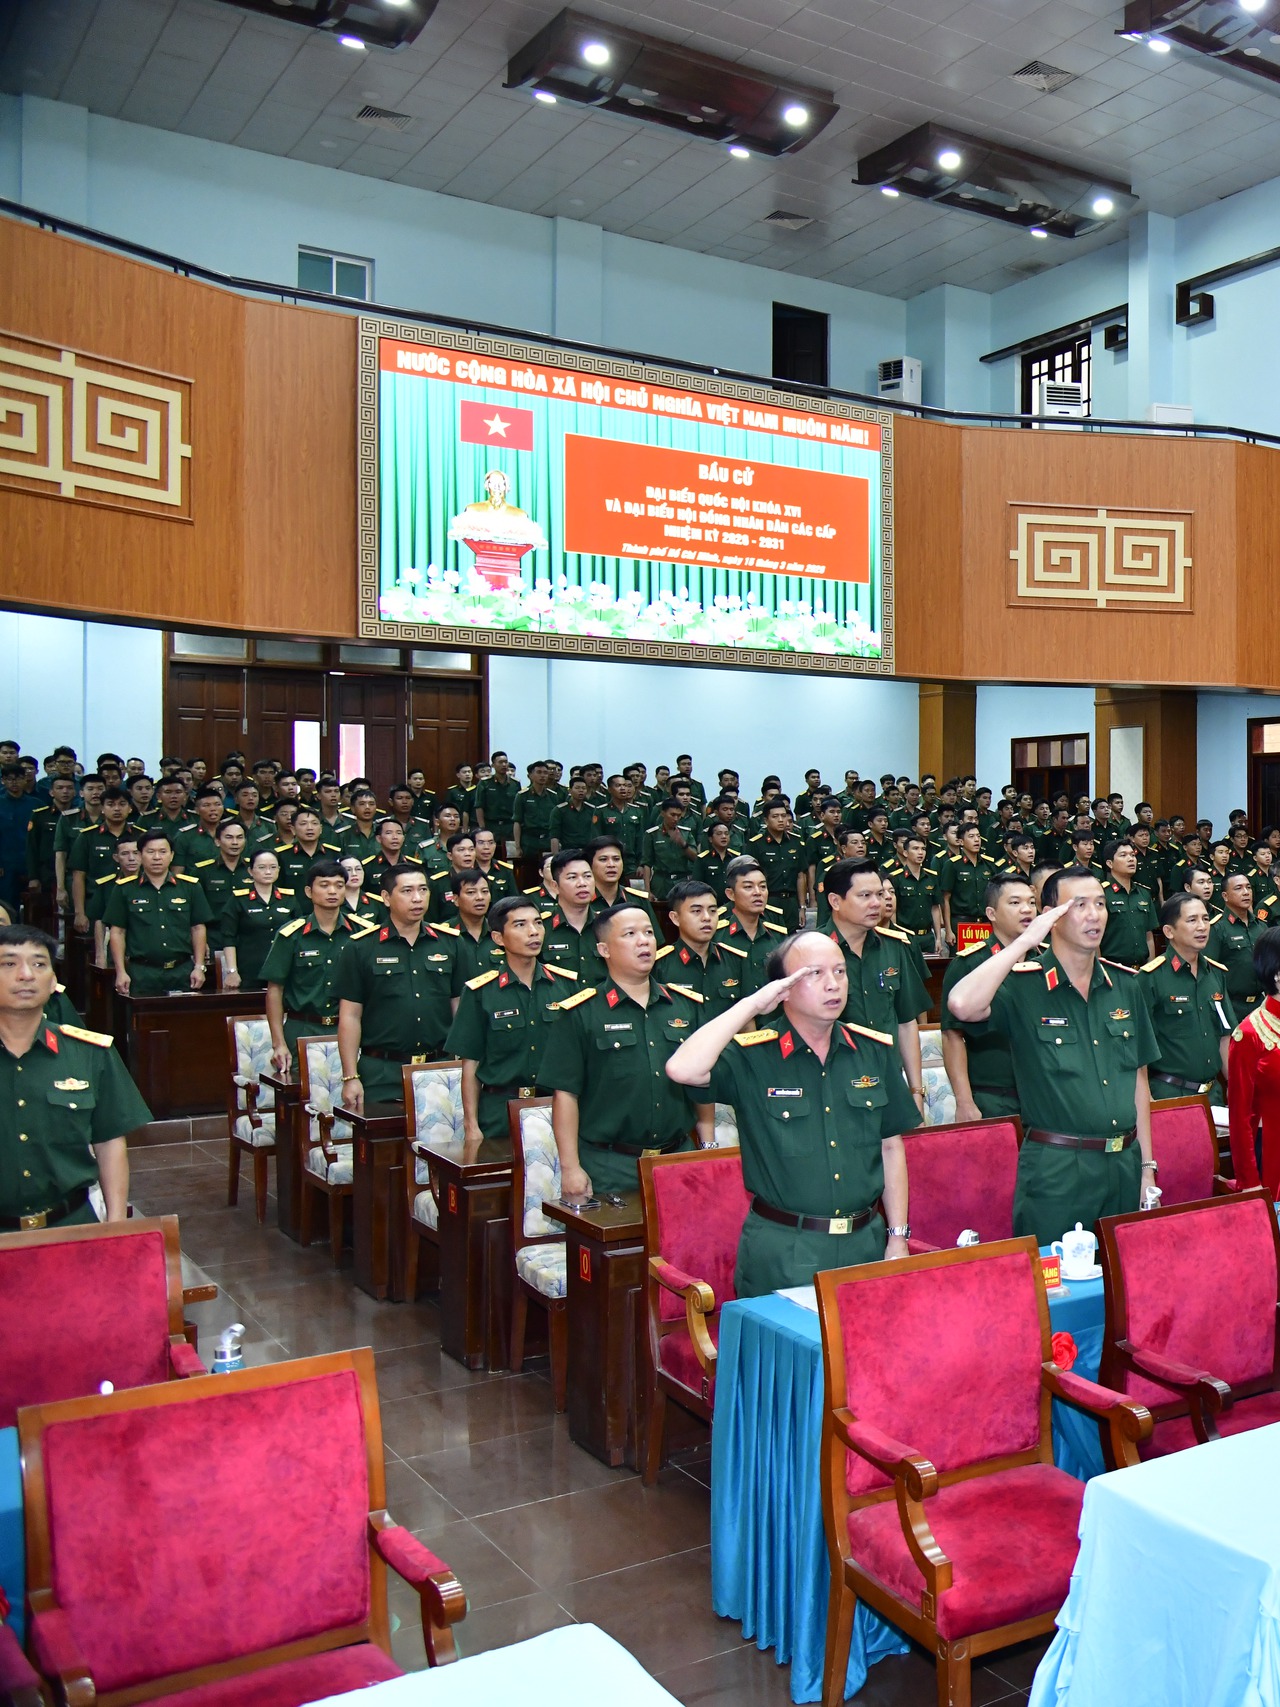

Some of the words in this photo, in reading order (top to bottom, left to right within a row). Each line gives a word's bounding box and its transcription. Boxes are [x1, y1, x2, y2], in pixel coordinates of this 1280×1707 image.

[397, 350, 450, 375] NƯỚC
[455, 359, 507, 385] CỘNG
[511, 368, 548, 392] HÒA
[552, 376, 576, 396] XÃ
[581, 381, 610, 404] HỘI
[614, 387, 648, 408] CHỦ
[653, 394, 702, 418] NGHĨA
[706, 403, 739, 425] VIỆT
[743, 409, 778, 430] NAM
[783, 416, 827, 438] MUÔN
[962, 926, 973, 939] LỐI
[975, 927, 989, 939] VÀO
